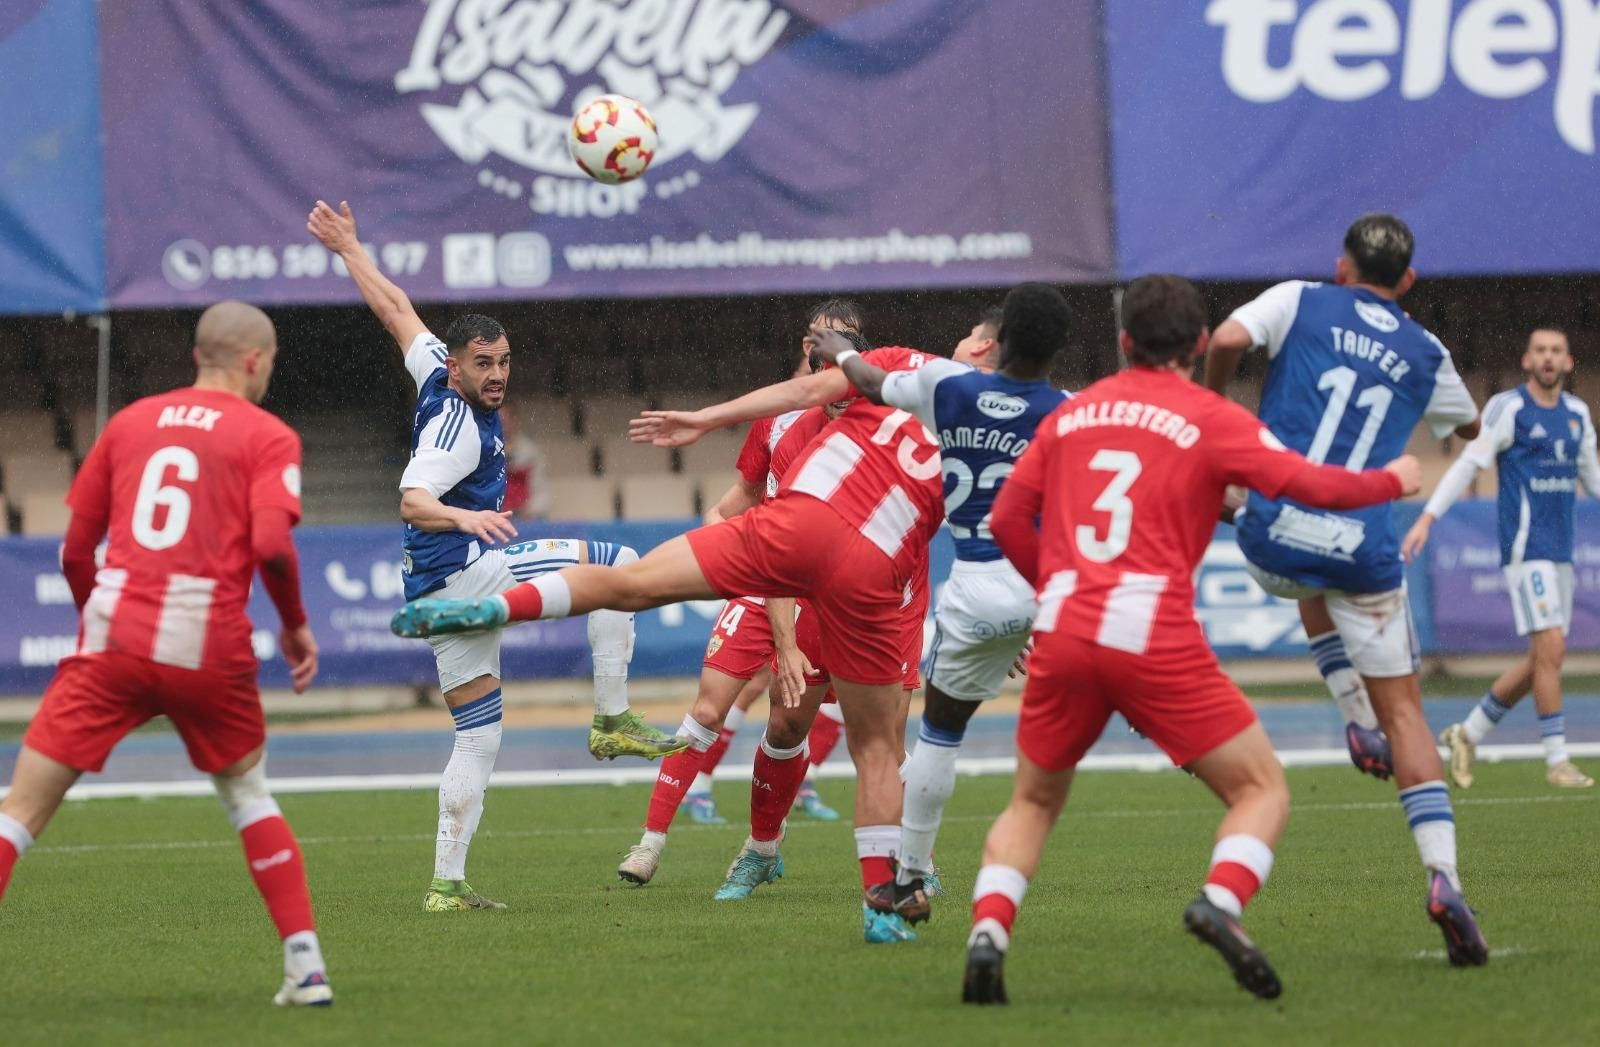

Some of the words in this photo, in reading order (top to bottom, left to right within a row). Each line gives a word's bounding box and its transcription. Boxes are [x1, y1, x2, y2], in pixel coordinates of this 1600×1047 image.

[157, 405, 223, 432] ALEX
[1056, 400, 1201, 450] BALLESTERO
[1307, 365, 1394, 474] 11
[131, 445, 199, 551] 6
[1075, 448, 1143, 564] 3
[1531, 570, 1545, 597] 8
